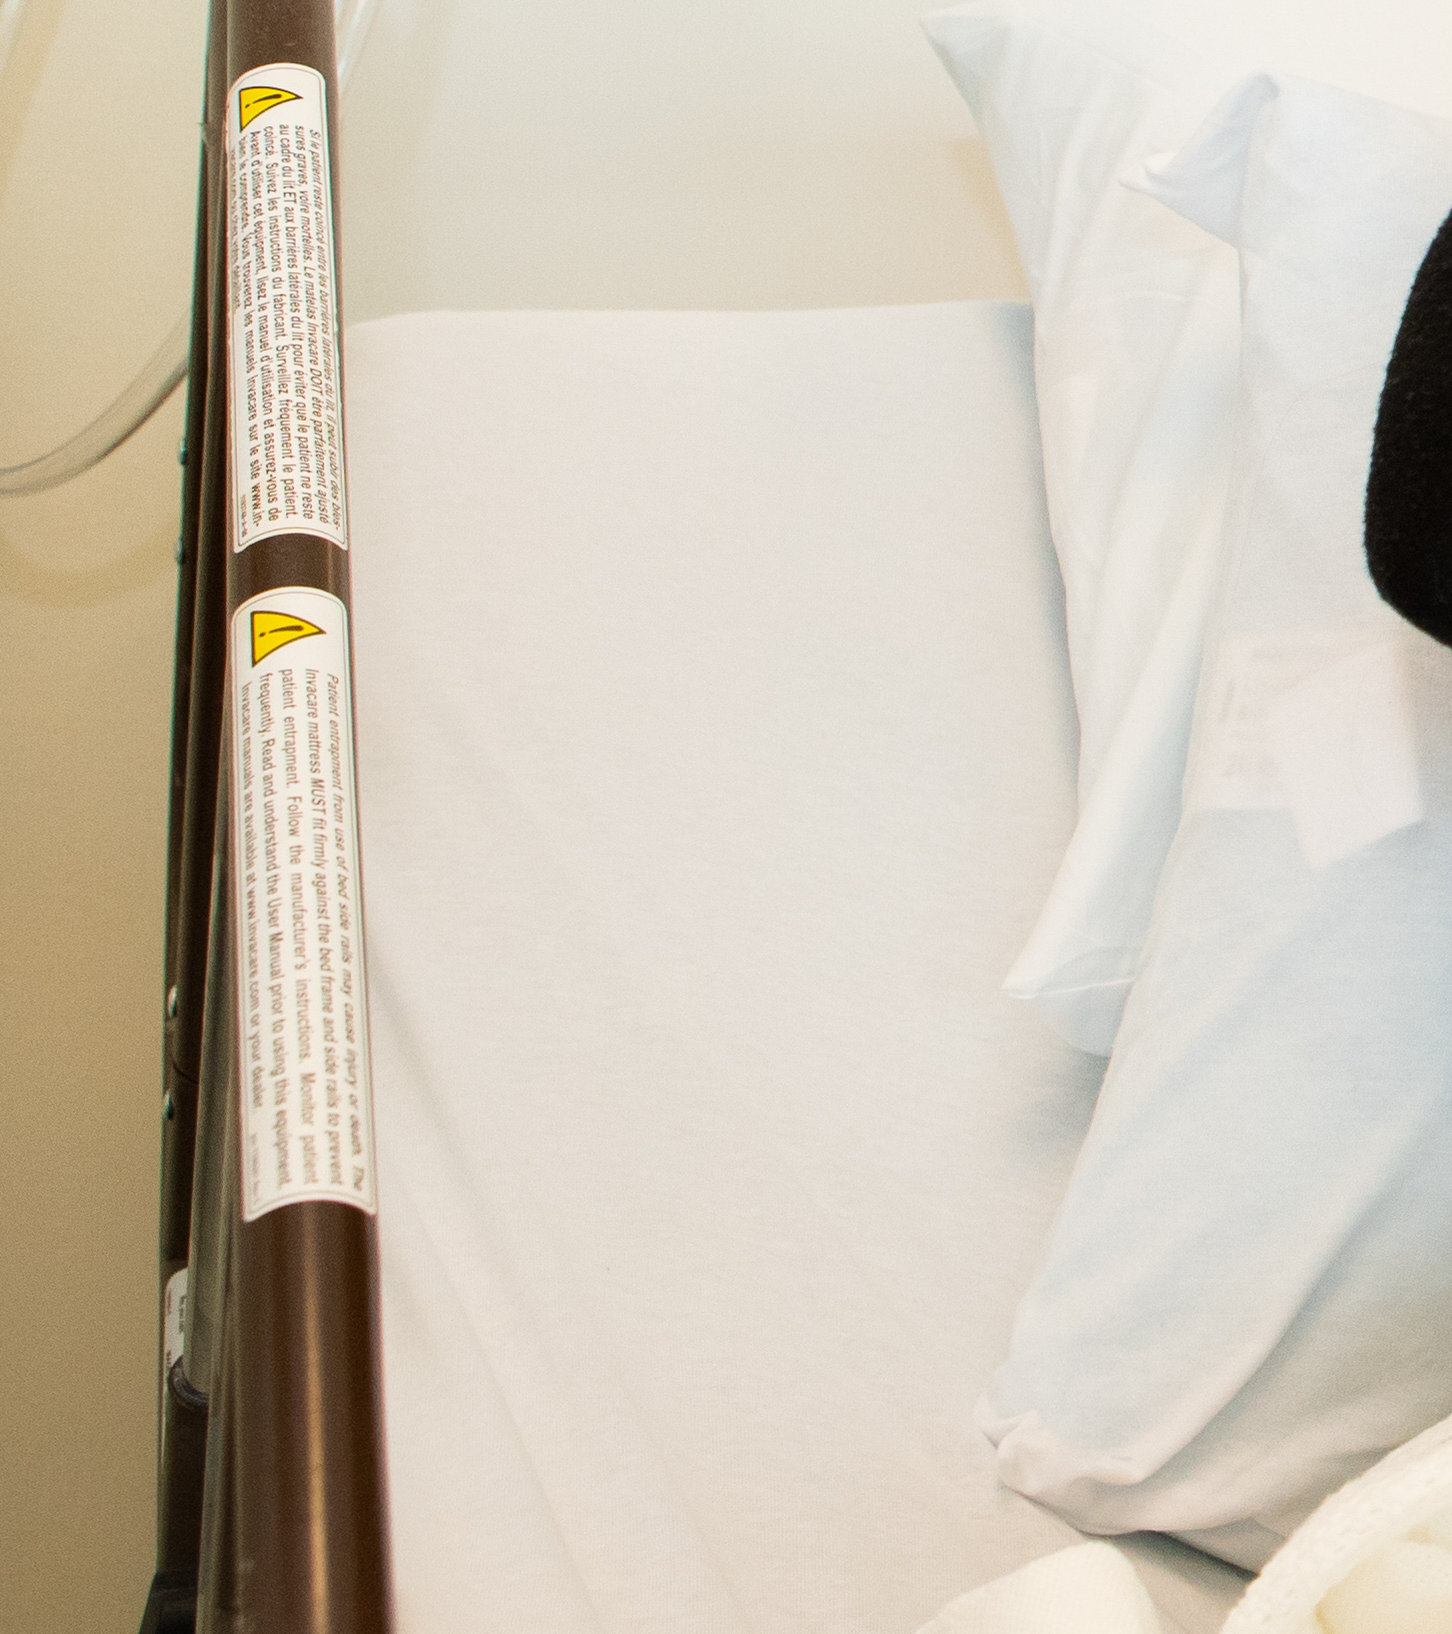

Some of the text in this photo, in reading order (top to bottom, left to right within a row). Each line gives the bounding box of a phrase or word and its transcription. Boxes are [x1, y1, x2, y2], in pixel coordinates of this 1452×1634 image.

[249, 131, 261, 158] Avant
[263, 126, 278, 160] coincé.
[250, 160, 264, 200] d'utiliser
[265, 163, 280, 193] Suivez
[252, 203, 264, 219] cet
[266, 197, 279, 211] les
[267, 215, 284, 273] instructions
[255, 277, 269, 300] lisez
[271, 277, 284, 289] du
[256, 302, 270, 311] le
[272, 294, 287, 340] fabricant.
[278, 124, 313, 519] au cadre du lit ET aux barrières latérales du lit pour éviter que le patient ne reste
[292, 125, 329, 524] sures graves, voire mortelles. Le matelas Invacare DOIT être parfaitement ajusté
[258, 315, 271, 352] manuel
[259, 355, 275, 415] d'utilisation
[274, 345, 291, 394] Surveillez
[262, 418, 275, 429] et
[263, 433, 278, 504] assurez-vous
[281, 464, 295, 473] le
[267, 508, 281, 521] de
[279, 479, 297, 518] patient.
[256, 673, 275, 737] frequently.
[277, 668, 297, 710] patient
[259, 738, 276, 771] Read
[260, 774, 277, 796] and
[285, 796, 304, 837] Follow
[262, 800, 281, 872] understand
[288, 845, 305, 865] the
[265, 874, 281, 895] the
[266, 898, 283, 929] User
[289, 873, 309, 971] manufacturer's
[304, 669, 342, 1185] Invacare mattress MUST fit firmly against the bed frame and side rails to prevent
[267, 931, 285, 981] Manual
[267, 983, 286, 1015] prior
[271, 1019, 285, 1034] to
[269, 1037, 288, 1078] using
[273, 1078, 290, 1106] this
[299, 1072, 316, 1126] Monitor
[298, 1134, 319, 1186] patient
